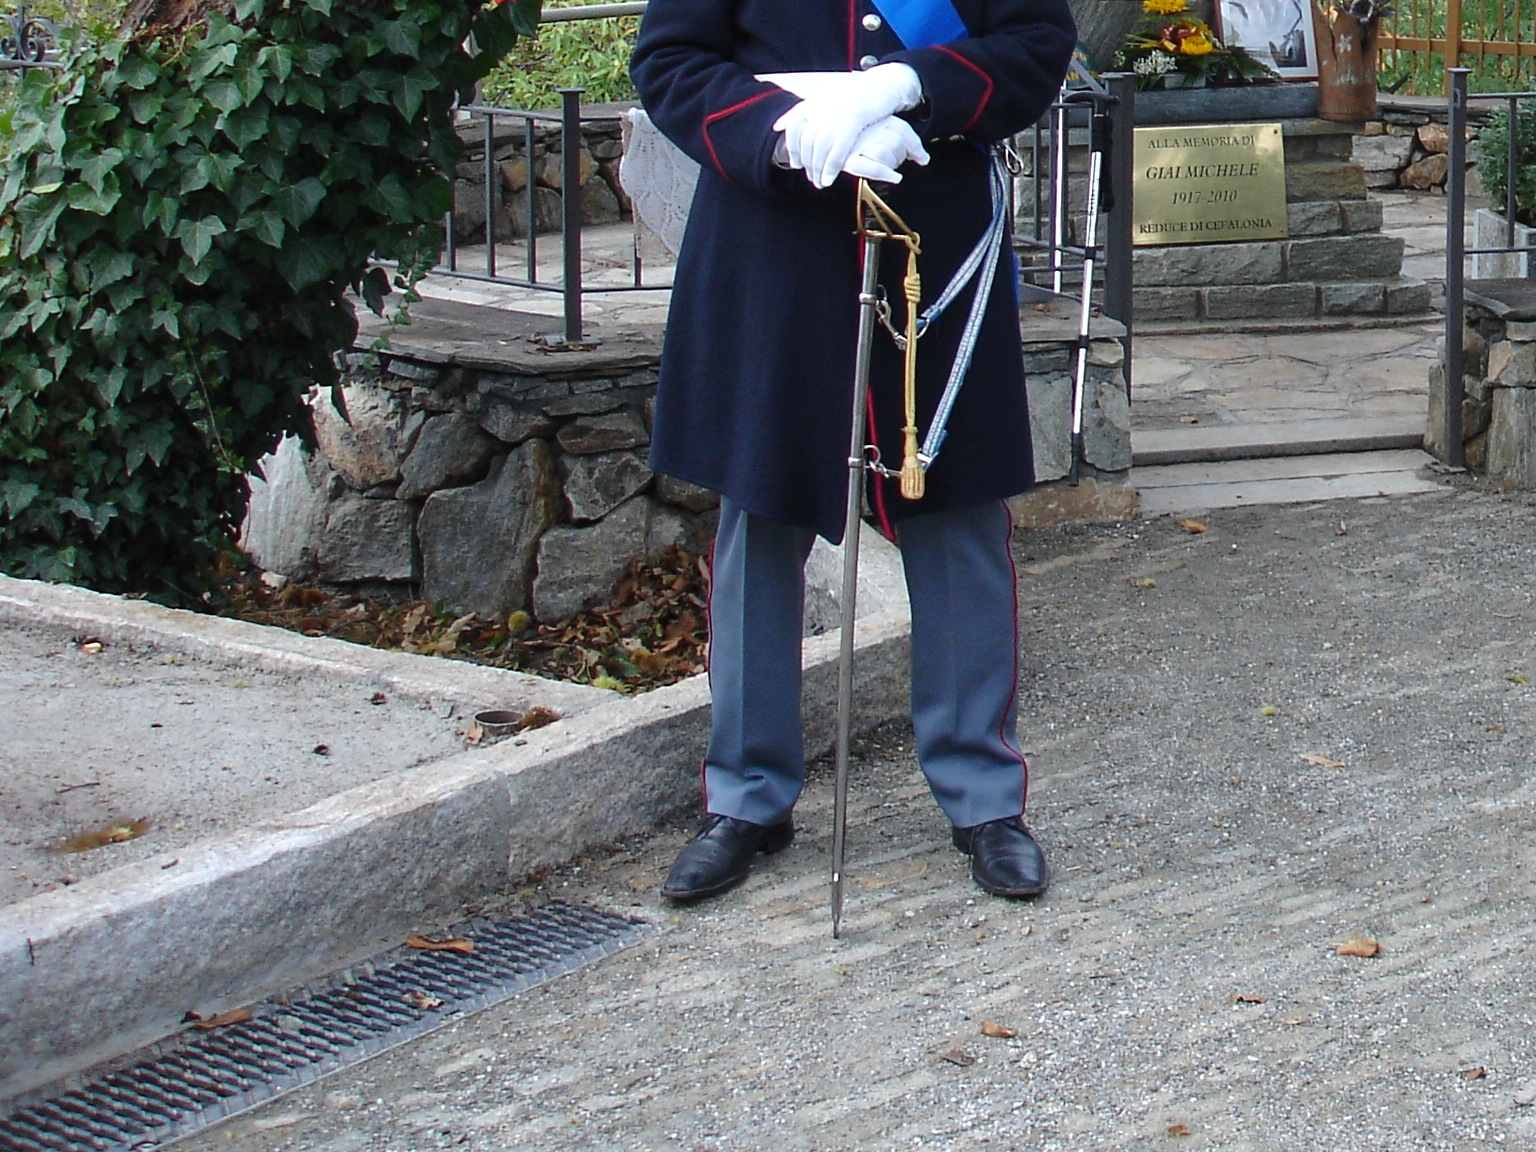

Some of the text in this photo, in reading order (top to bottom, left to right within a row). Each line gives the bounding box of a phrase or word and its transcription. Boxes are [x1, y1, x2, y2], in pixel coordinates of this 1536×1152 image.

[1147, 135, 1256, 149] ALLA MEMORIA DI
[1146, 163, 1260, 180] GIAI MICHELE
[1172, 190, 1238, 205] 1917-2010
[1139, 218, 1273, 234] REDUCE DI CEFALONIA
